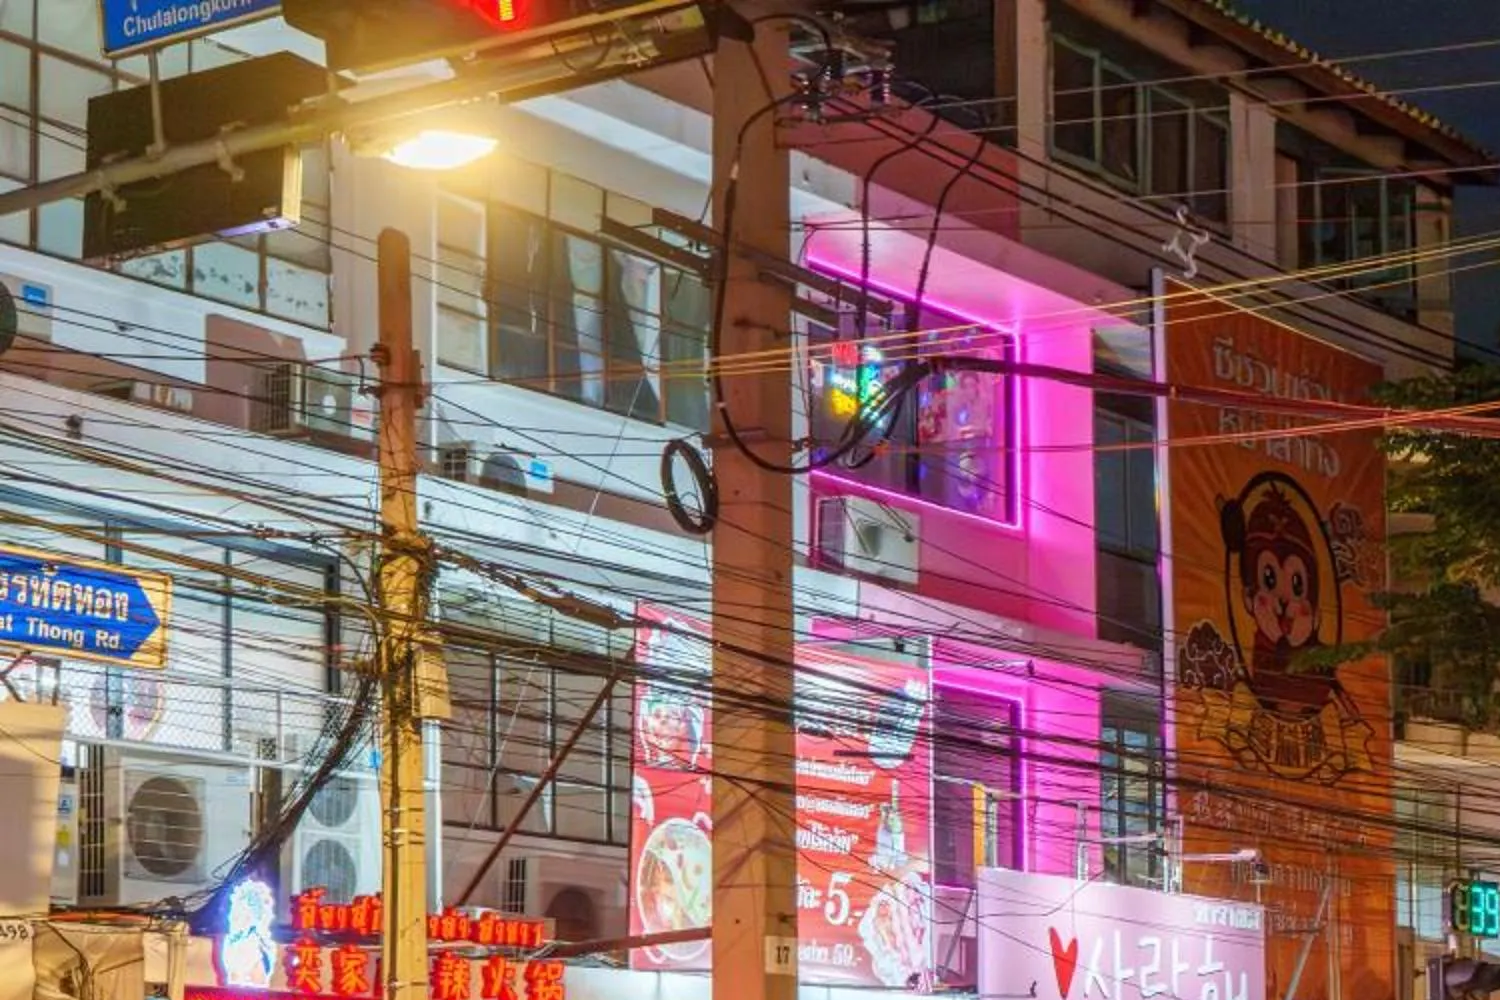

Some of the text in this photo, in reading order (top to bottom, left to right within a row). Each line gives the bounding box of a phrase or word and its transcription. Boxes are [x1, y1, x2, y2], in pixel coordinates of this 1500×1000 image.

[27, 617, 84, 648] Thong
[1471, 886, 1499, 934] 39
[776, 945, 790, 965] 17
